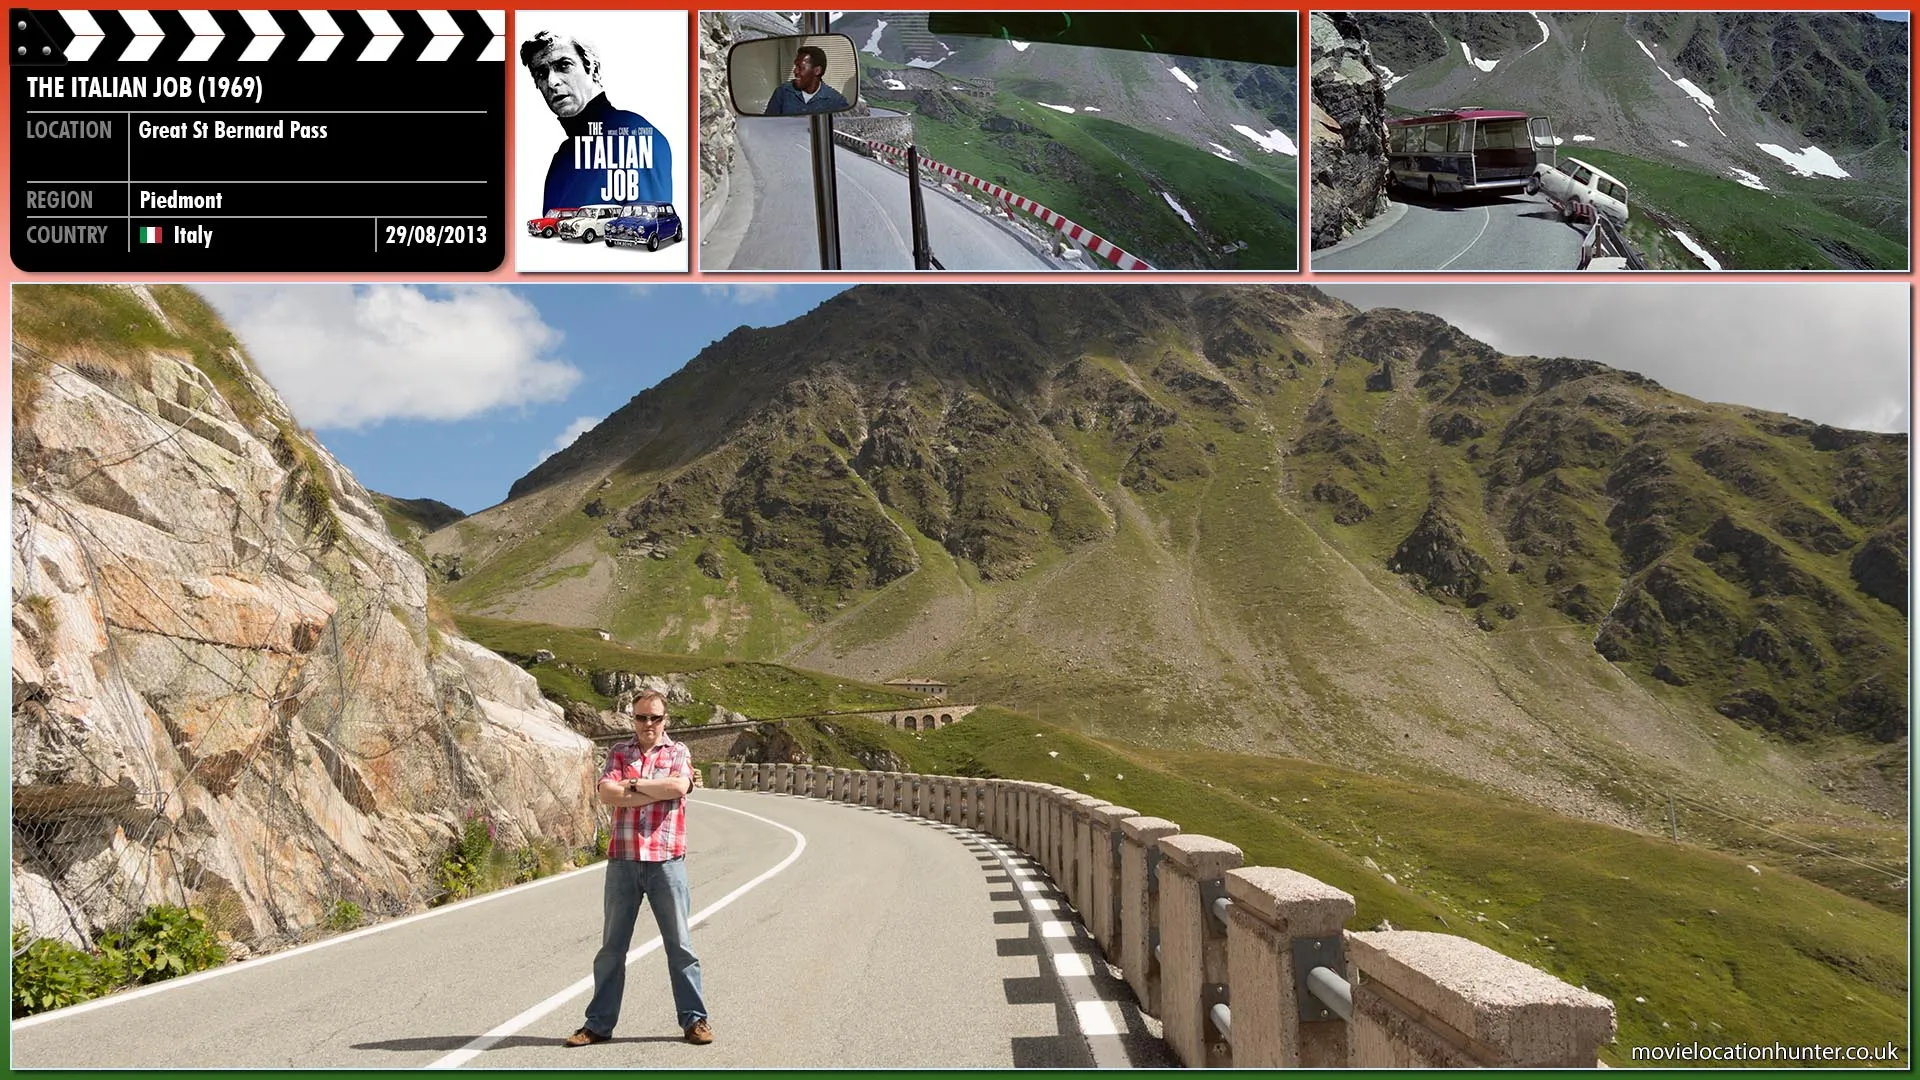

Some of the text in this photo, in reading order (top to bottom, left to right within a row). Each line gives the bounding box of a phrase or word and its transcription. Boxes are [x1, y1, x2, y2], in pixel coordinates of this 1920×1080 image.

[588, 122, 603, 135] THE
[575, 136, 653, 169] ITALIAN
[601, 170, 639, 201] JOB
